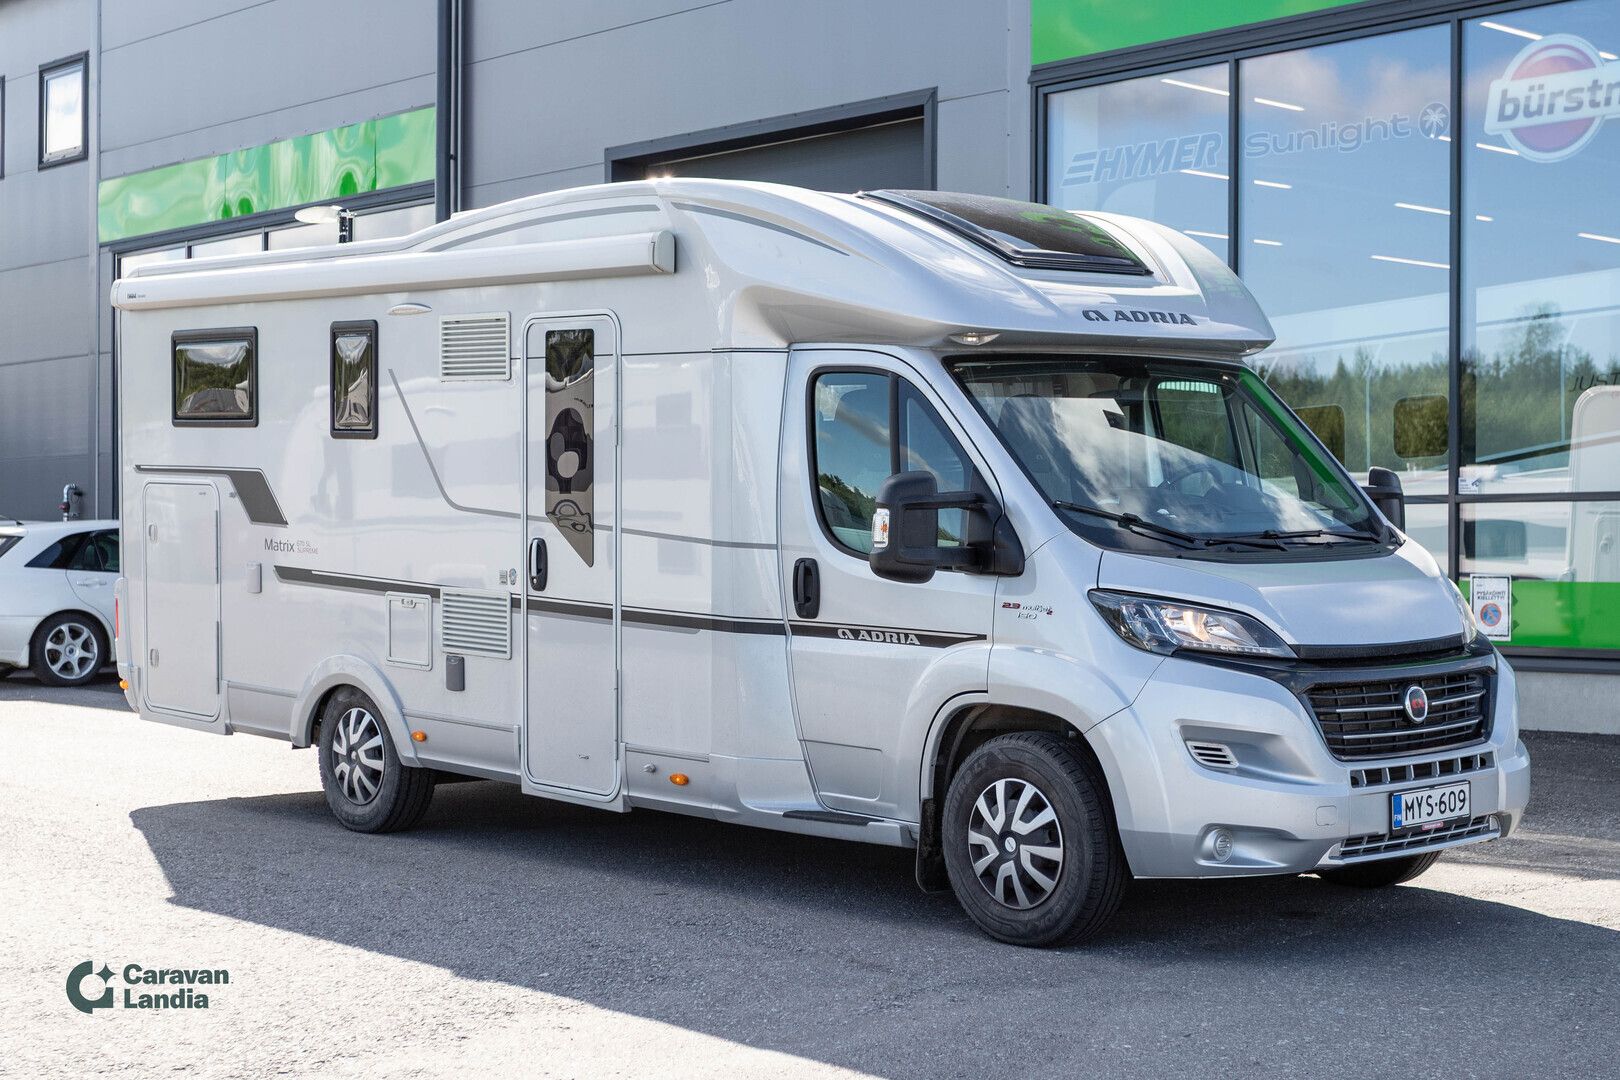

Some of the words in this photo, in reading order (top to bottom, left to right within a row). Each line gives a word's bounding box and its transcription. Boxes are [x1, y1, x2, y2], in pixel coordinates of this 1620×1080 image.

[1244, 112, 1411, 158] Sunlight
[1091, 132, 1223, 183] HYMER
[1114, 309, 1198, 326] ADRIA
[264, 538, 295, 553] Matrix
[858, 630, 921, 645] ADRIA
[1404, 789, 1466, 821] MYS-609
